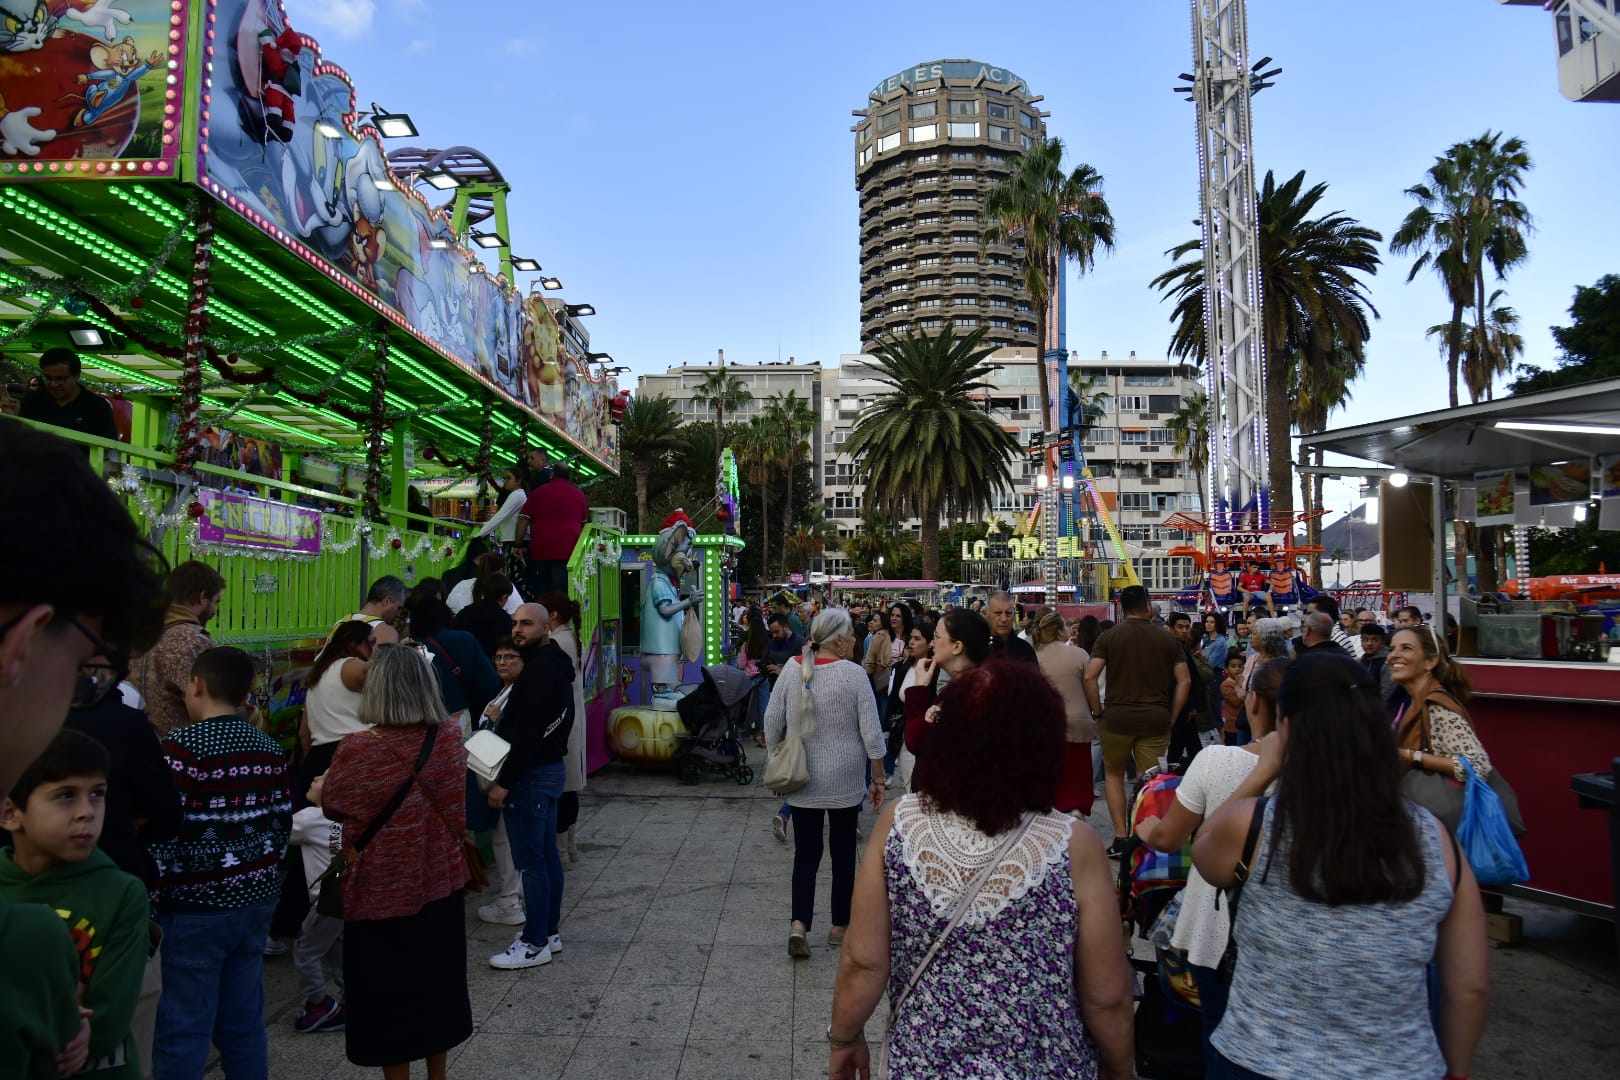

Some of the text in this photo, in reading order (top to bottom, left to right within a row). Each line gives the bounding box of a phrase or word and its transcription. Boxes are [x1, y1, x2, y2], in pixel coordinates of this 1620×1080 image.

[207, 498, 317, 540] ENTRADA
[1215, 534, 1263, 545] CRAZY
[962, 540, 987, 560] LA
[1560, 577, 1578, 585] Air
